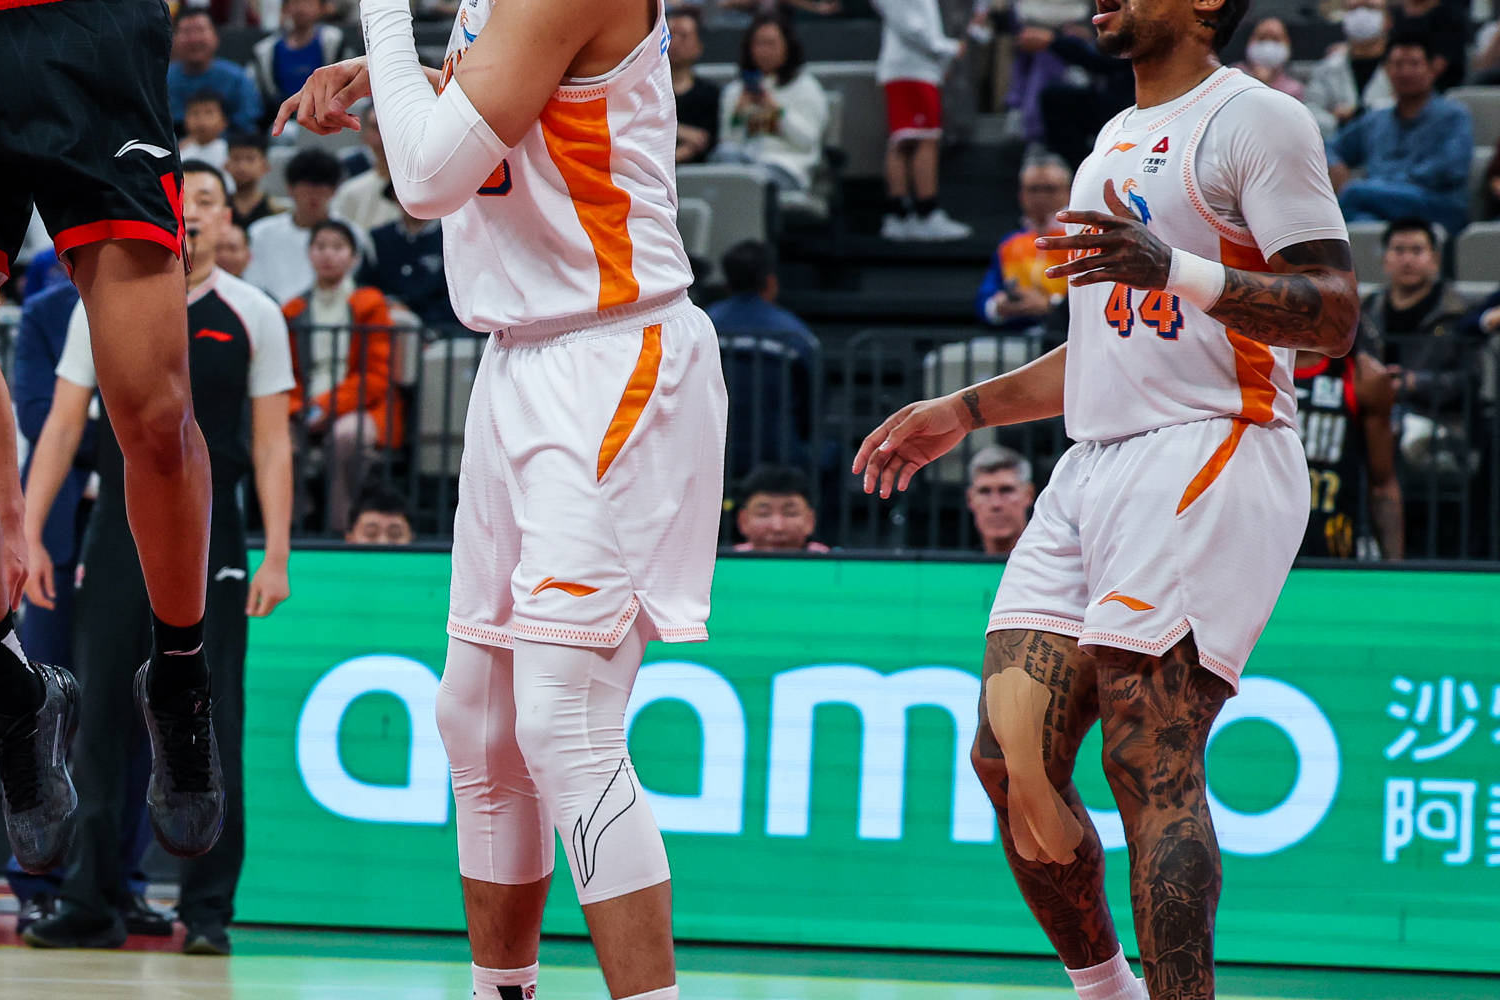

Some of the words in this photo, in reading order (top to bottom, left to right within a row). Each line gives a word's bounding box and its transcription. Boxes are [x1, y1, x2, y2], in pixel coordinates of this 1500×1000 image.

[1143, 165, 1159, 174] CGB
[1104, 283, 1184, 341] 44
[295, 654, 1340, 856] aamo
[1384, 675, 1500, 763] 沙
[1383, 777, 1500, 866] 阿
